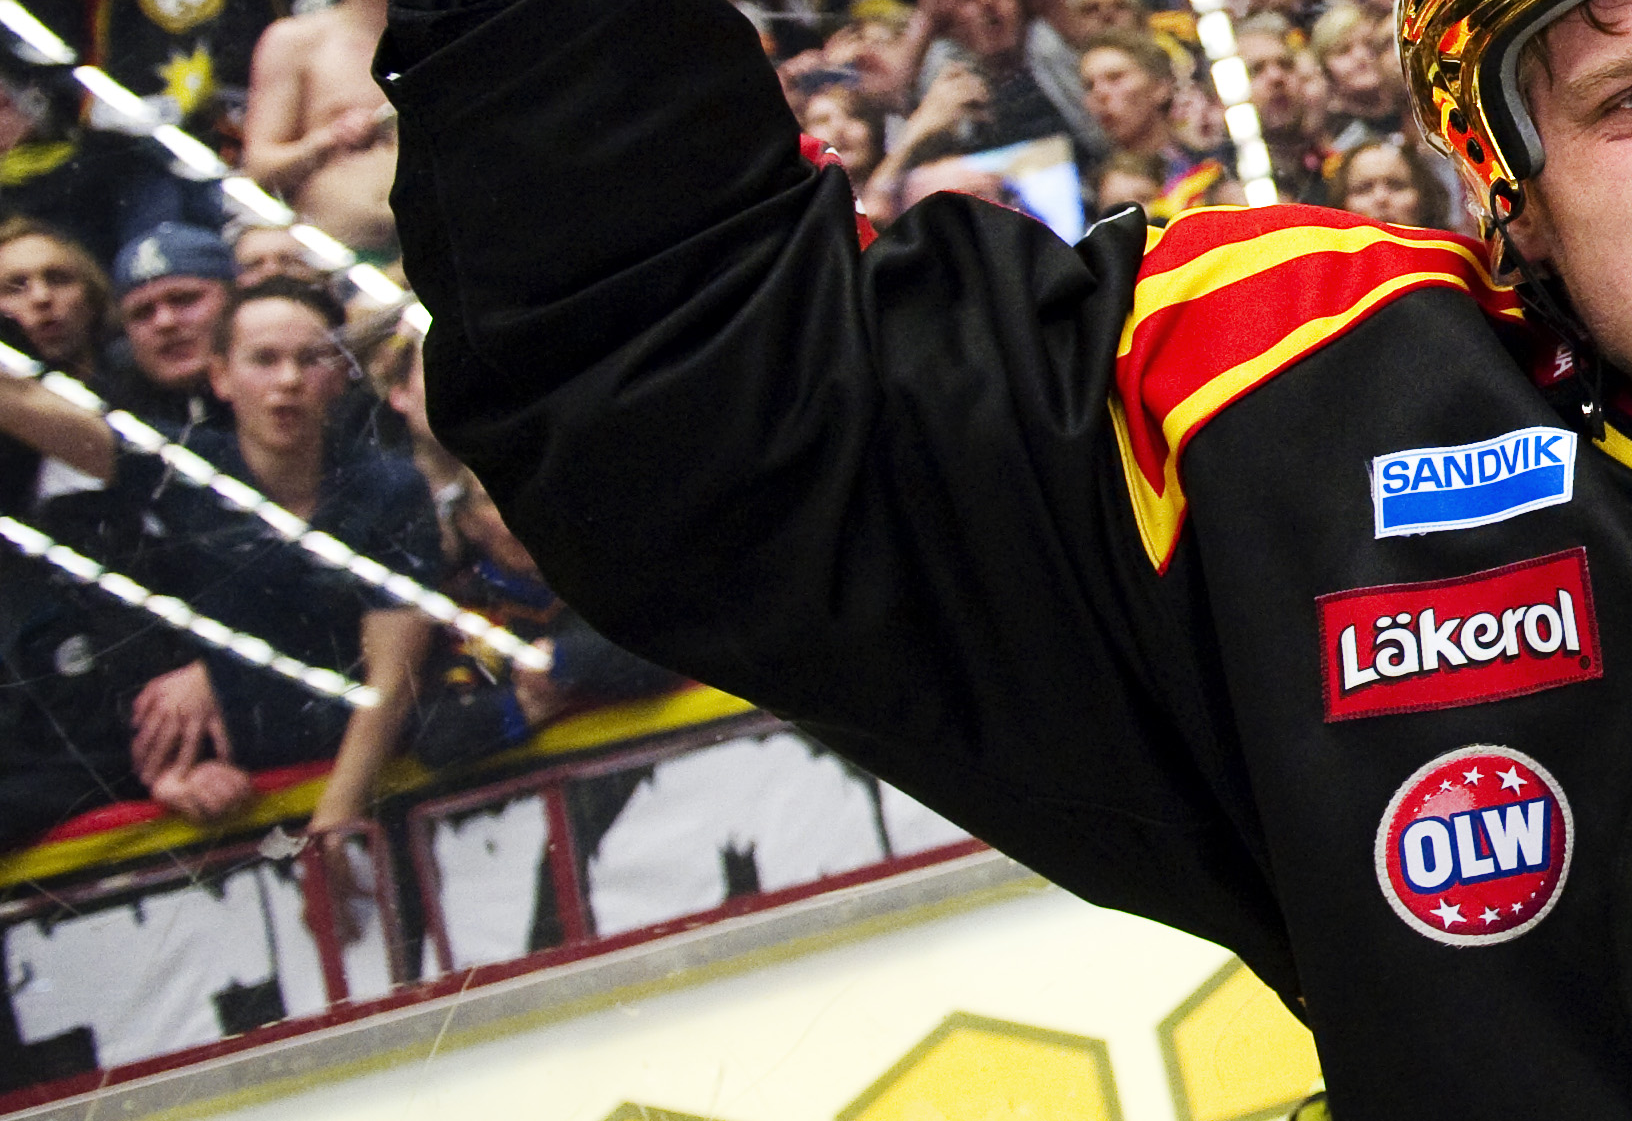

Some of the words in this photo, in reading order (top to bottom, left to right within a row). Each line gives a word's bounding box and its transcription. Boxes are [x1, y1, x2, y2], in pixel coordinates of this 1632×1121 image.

[1381, 433, 1565, 495] SANDVIK
[1338, 587, 1582, 692] Läkerol
[1402, 798, 1548, 891] OLW
